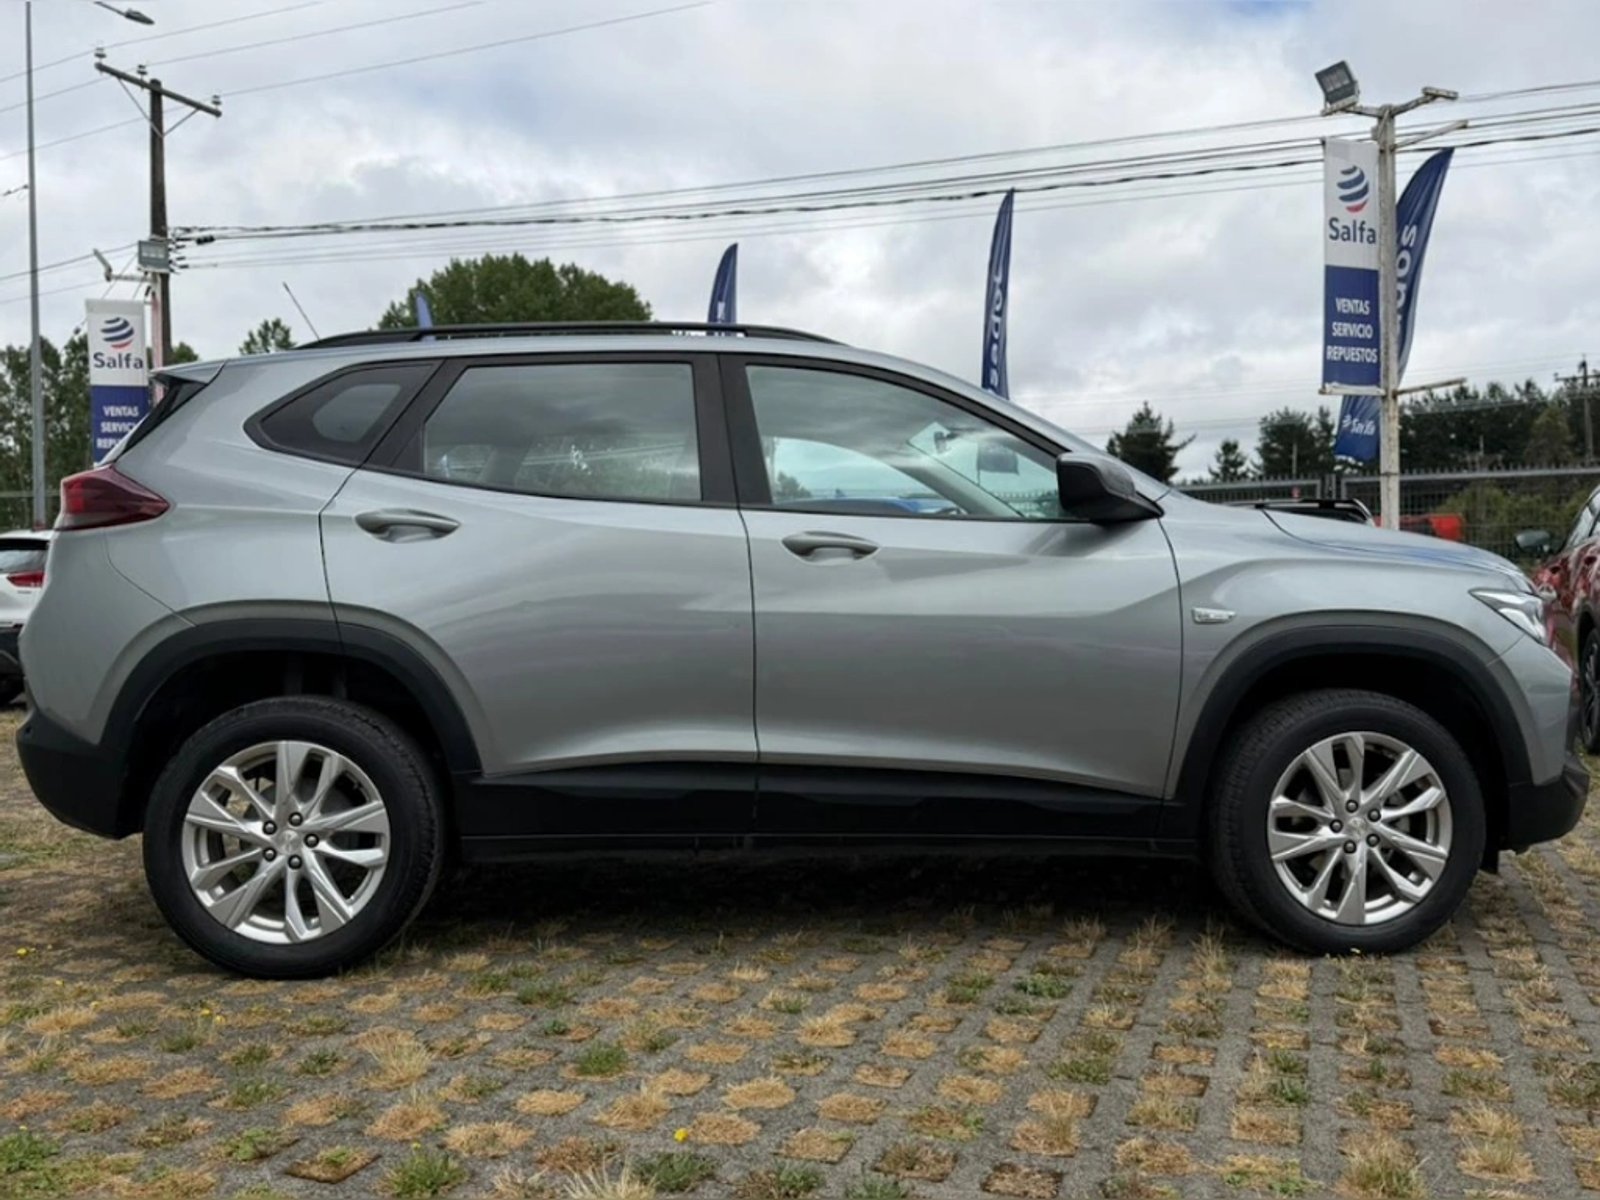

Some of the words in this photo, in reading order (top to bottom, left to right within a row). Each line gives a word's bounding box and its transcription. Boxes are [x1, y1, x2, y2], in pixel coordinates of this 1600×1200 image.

[1328, 217, 1376, 244] Salfa
[1335, 297, 1370, 315] VENTAS
[1331, 321, 1373, 339] SERVICIO
[93, 352, 143, 369] Salfa
[1326, 345, 1378, 363] REPUESTOS
[103, 406, 139, 417] VENTAS
